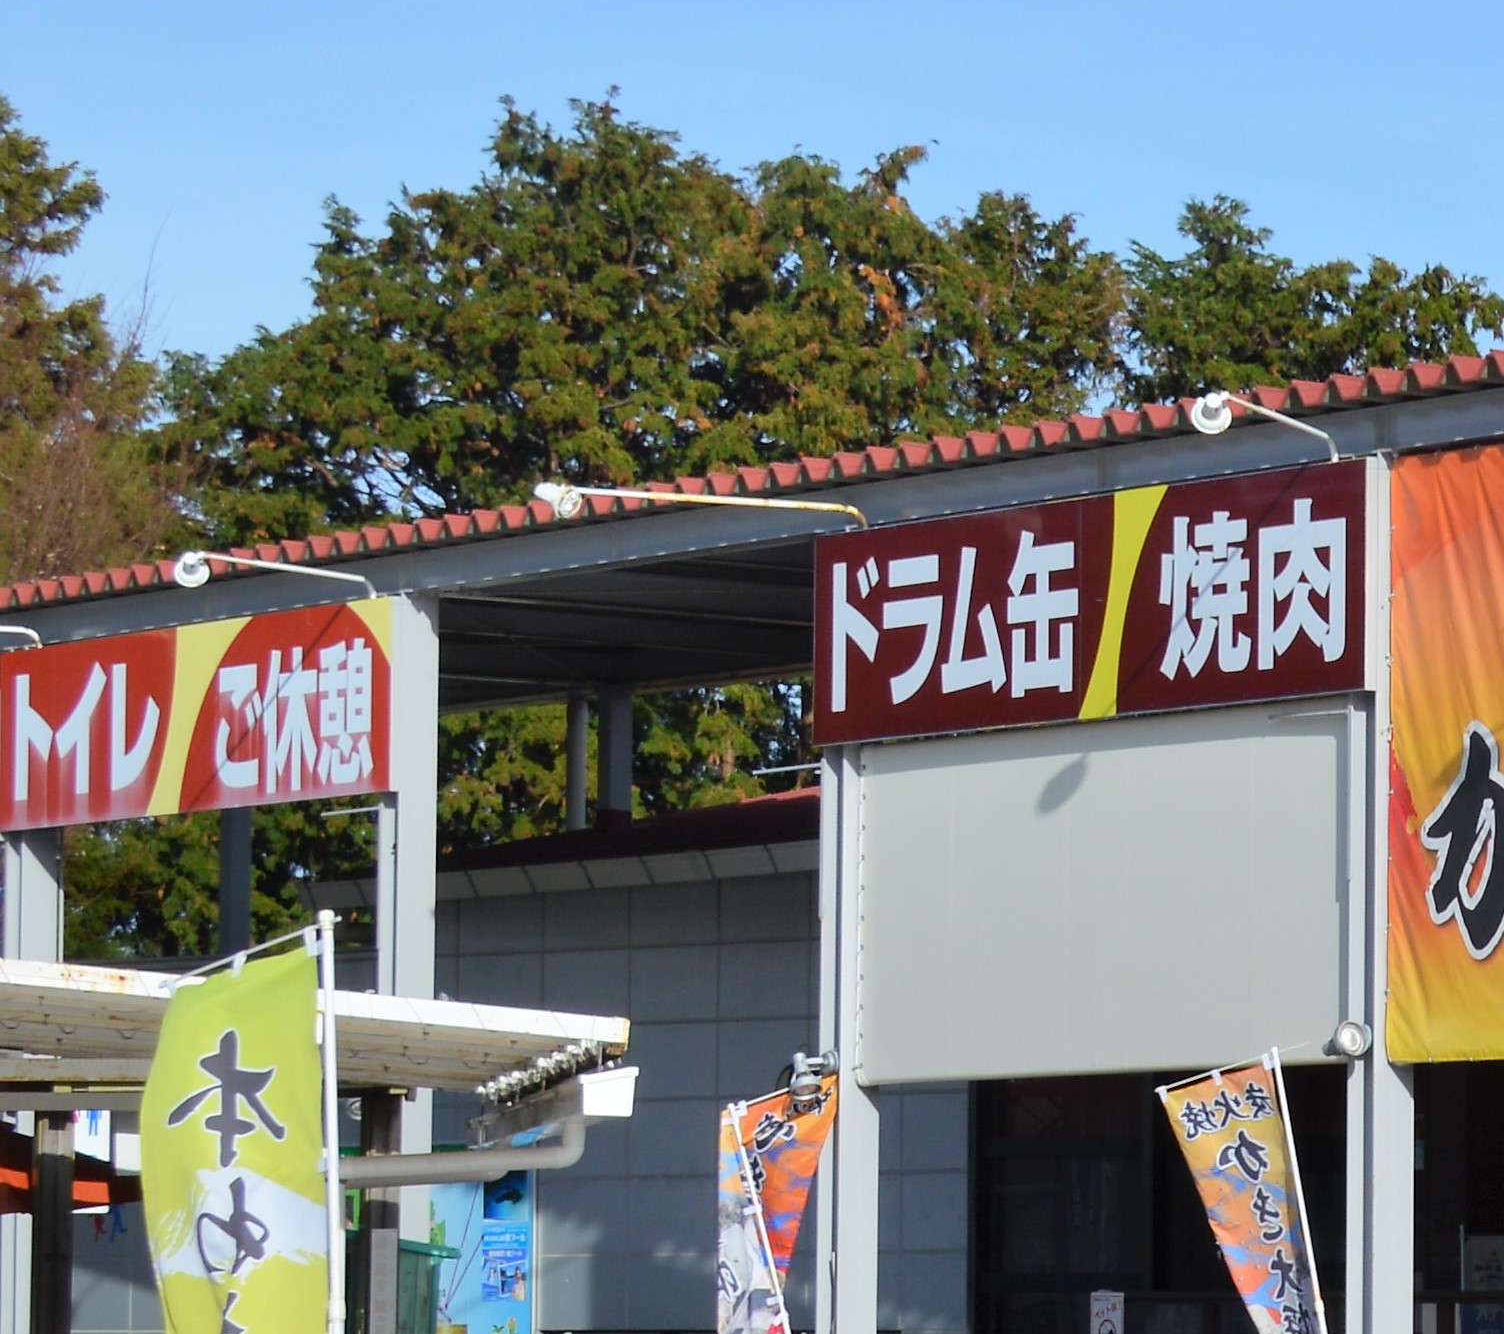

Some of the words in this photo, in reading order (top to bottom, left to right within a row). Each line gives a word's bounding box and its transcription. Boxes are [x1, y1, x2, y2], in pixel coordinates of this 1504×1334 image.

[831, 530, 1080, 712] ドラム缶
[1159, 498, 1347, 681] 焼肉
[13, 661, 160, 802] トイレ
[214, 638, 374, 794] ご休憩
